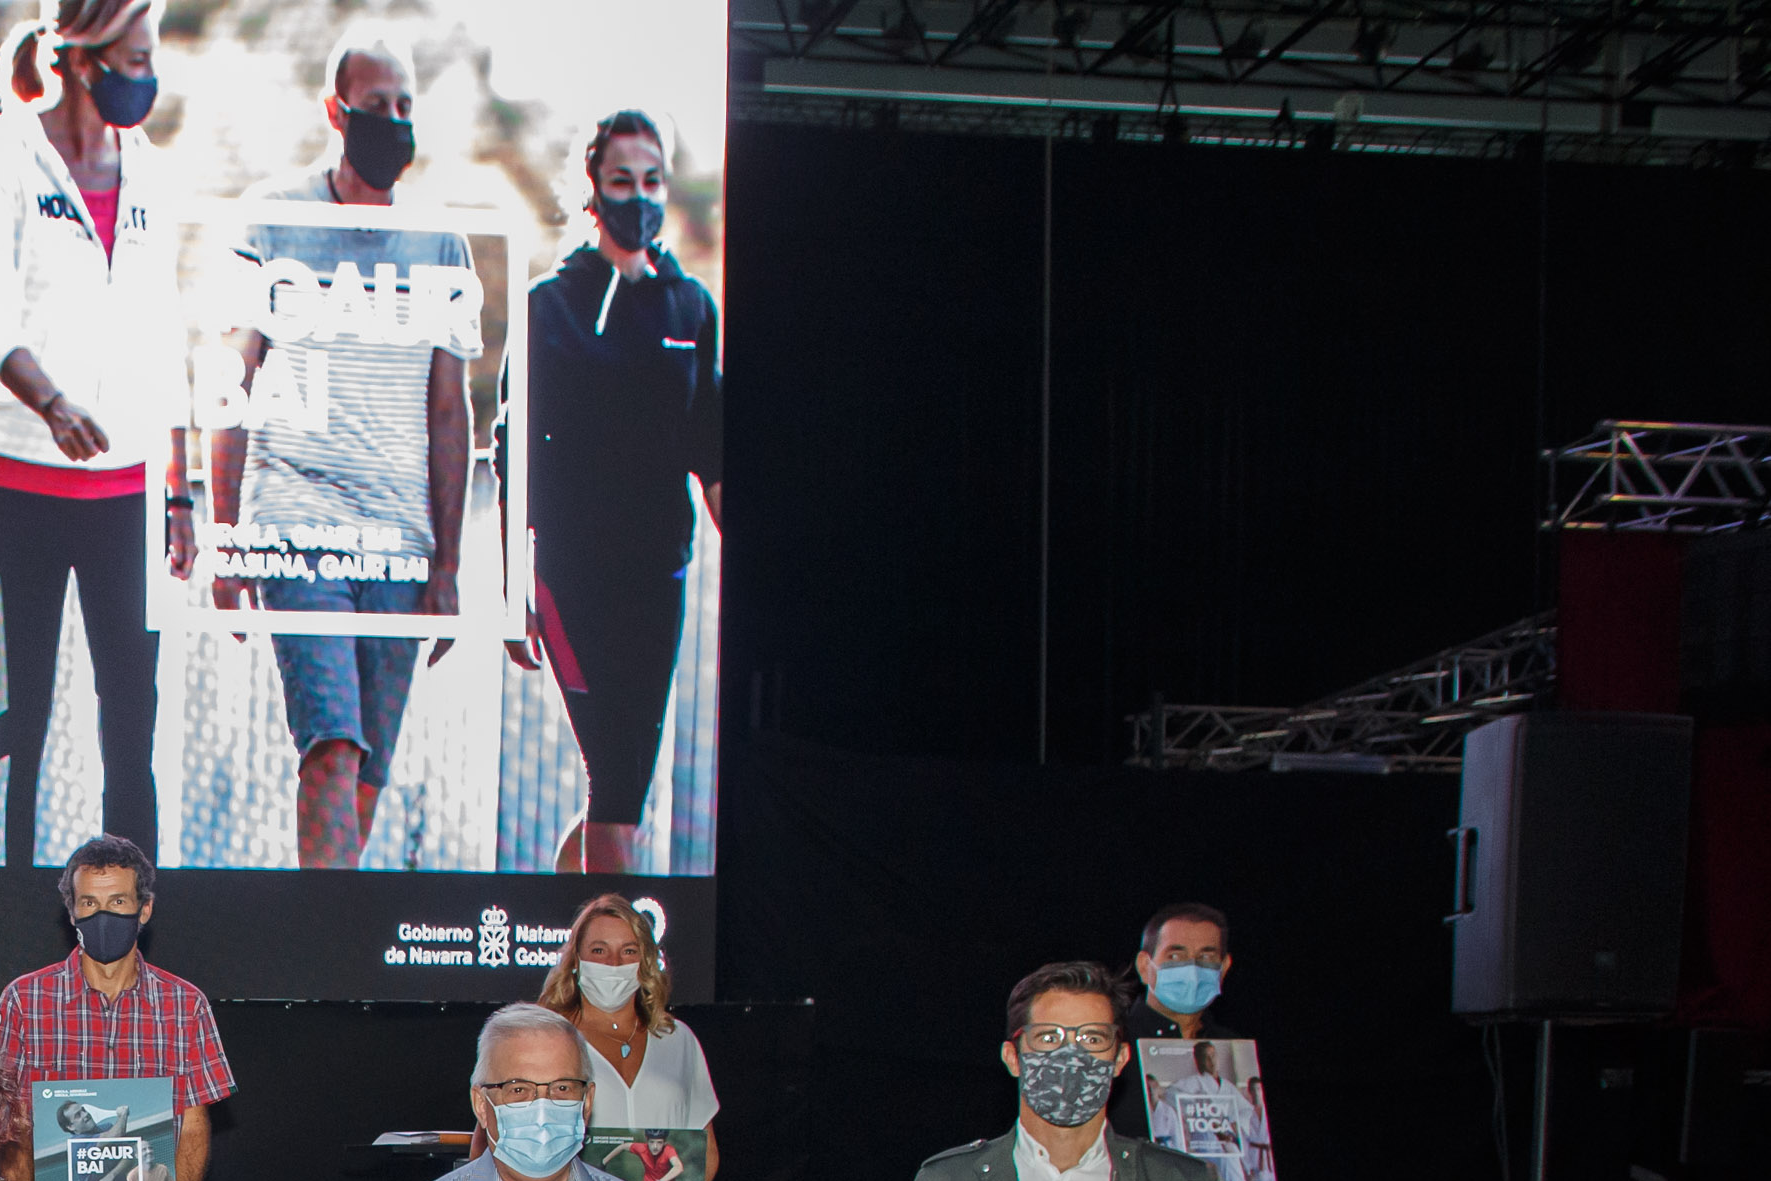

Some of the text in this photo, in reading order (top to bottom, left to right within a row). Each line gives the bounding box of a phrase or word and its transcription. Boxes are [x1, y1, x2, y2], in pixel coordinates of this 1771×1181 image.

[228, 257, 484, 346] GAUR
[397, 923, 474, 943] Gobierno
[515, 925, 572, 943] Nafarr
[384, 946, 473, 966] de Navarra
[1186, 1117, 1233, 1134] TOCA
[76, 1146, 134, 1161] #GAUR
[77, 1161, 104, 1175] BAI
